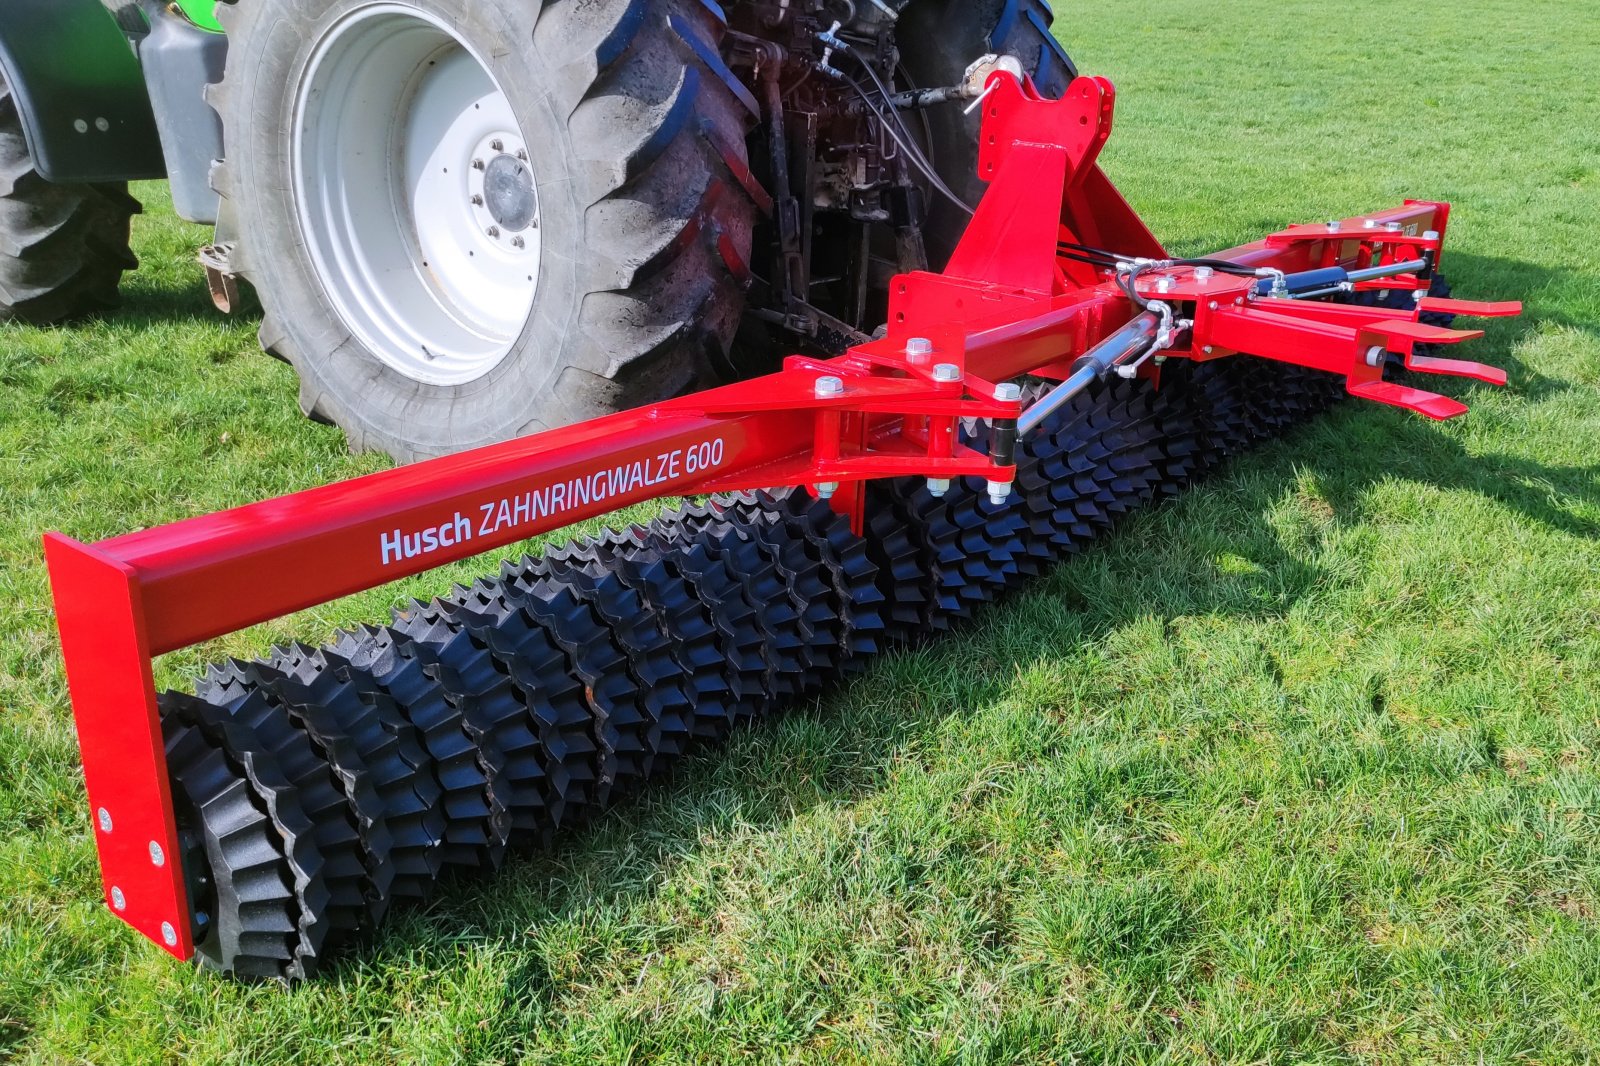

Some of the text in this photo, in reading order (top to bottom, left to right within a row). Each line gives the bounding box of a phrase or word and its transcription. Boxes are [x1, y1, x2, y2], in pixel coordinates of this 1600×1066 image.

[380, 438, 724, 565] Husch ZAHNRINGWALZE 600
